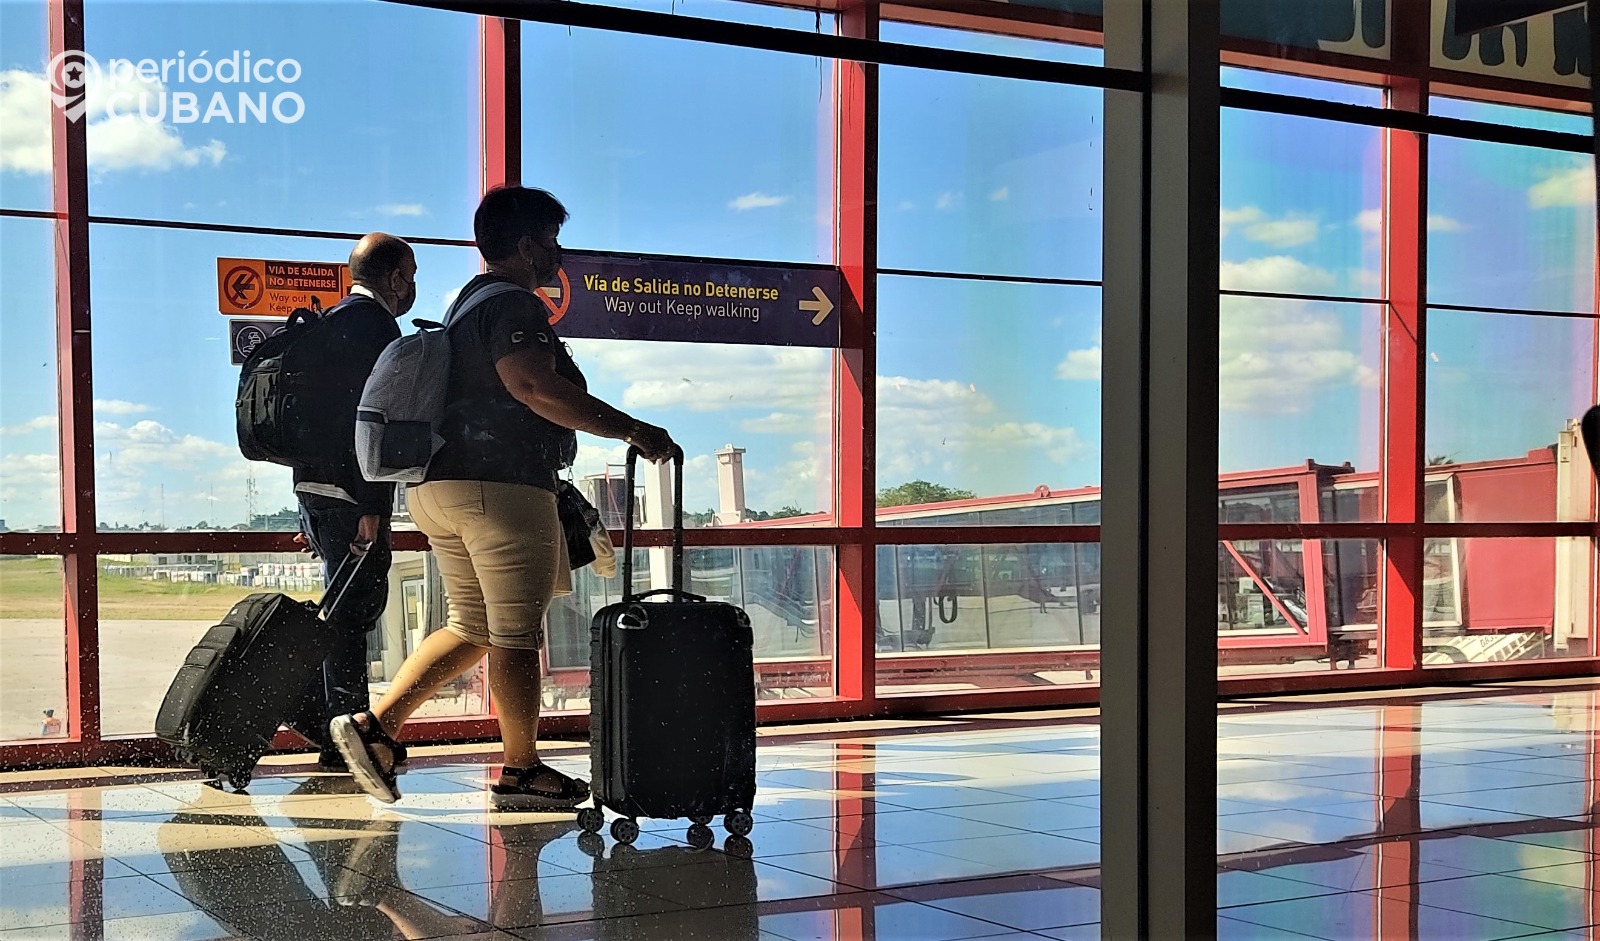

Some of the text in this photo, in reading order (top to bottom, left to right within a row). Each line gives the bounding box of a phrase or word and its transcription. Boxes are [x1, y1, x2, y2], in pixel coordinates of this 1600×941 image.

[268, 266, 334, 277] VIA DE SALIDA
[269, 278, 336, 288] NO DETENERSE
[583, 274, 779, 300] Vía de Salida no Detenerse
[270, 292, 289, 303] Way
[269, 303, 292, 314] Keep
[604, 296, 760, 323] Way out Keep walking
